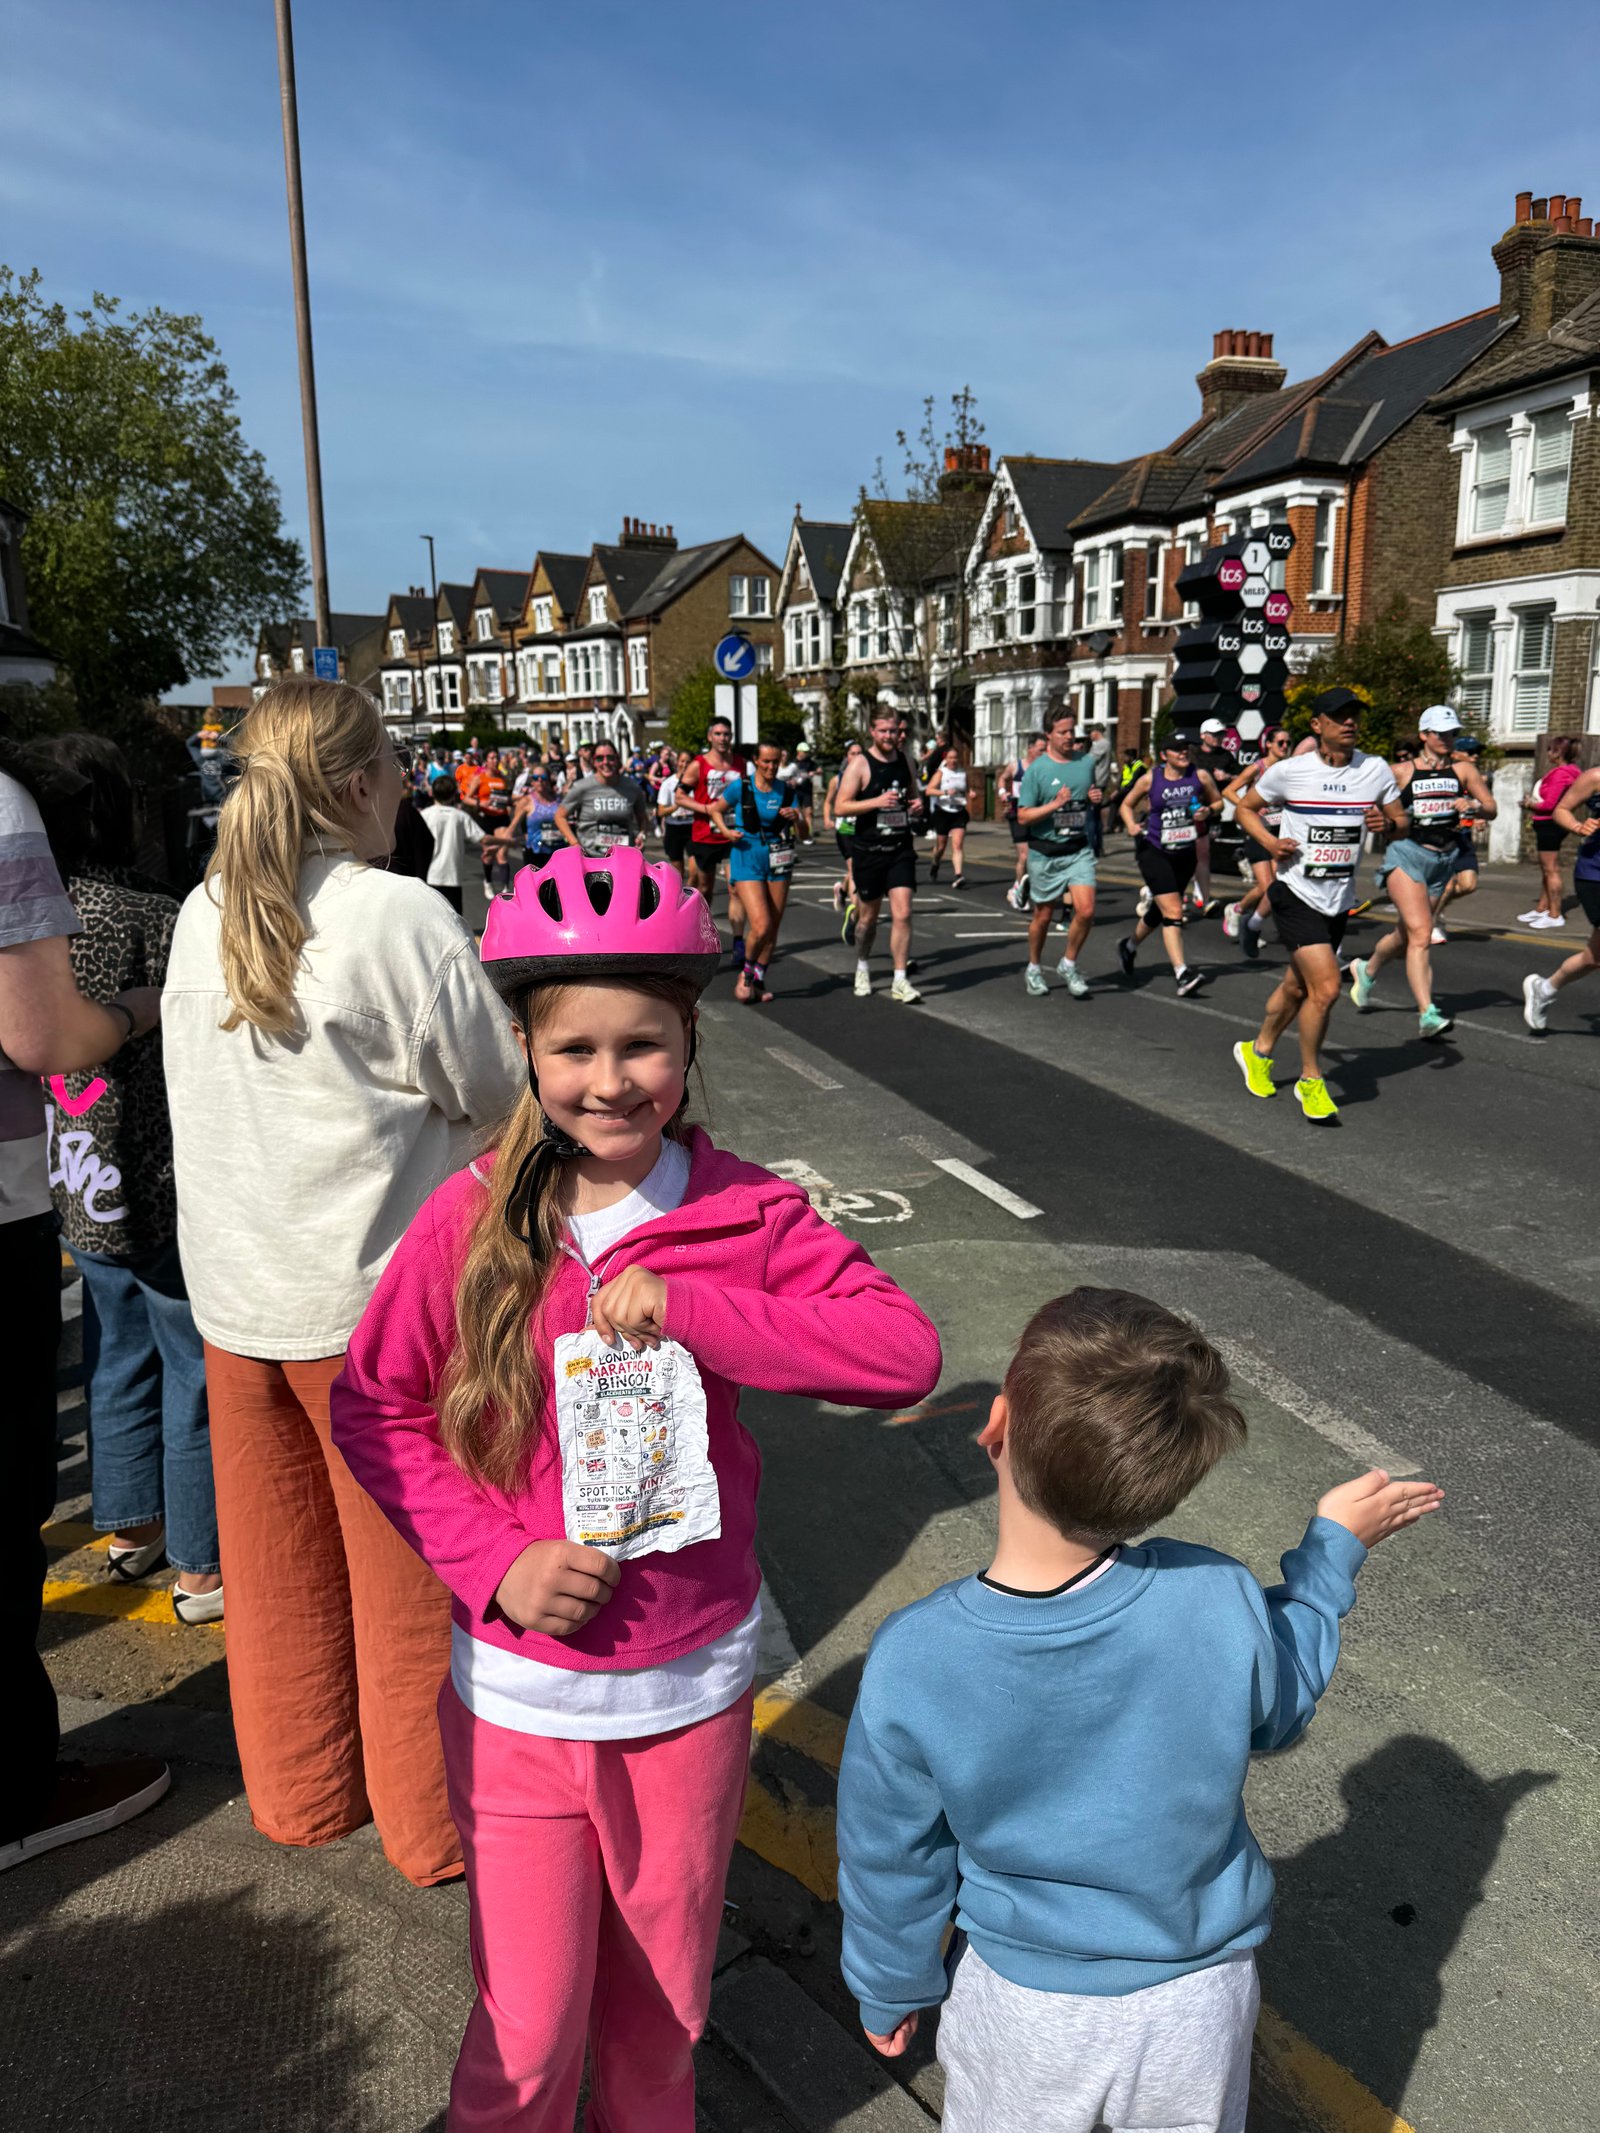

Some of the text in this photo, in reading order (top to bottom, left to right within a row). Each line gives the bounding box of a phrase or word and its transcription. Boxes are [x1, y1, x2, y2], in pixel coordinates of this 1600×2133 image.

[1269, 532, 1291, 549] tcs
[1252, 550, 1258, 564] 1
[1220, 567, 1243, 583] tcs
[1243, 586, 1267, 597] MILES
[1266, 601, 1289, 617] tcs
[1242, 617, 1264, 634] tcs
[1218, 634, 1241, 651] tcs
[1265, 634, 1287, 651] tcs
[1221, 737, 1237, 752] cs
[1323, 784, 1347, 792] DAVID
[593, 798, 628, 811] STEPH
[1310, 828, 1332, 842] tcs
[1314, 849, 1351, 862] 25070
[599, 1350, 642, 1366] LONDON
[589, 1360, 653, 1379] MARATHON
[598, 1373, 649, 1391] BINGO!
[579, 1476, 663, 1498] SPOT. TICK. WIN!
